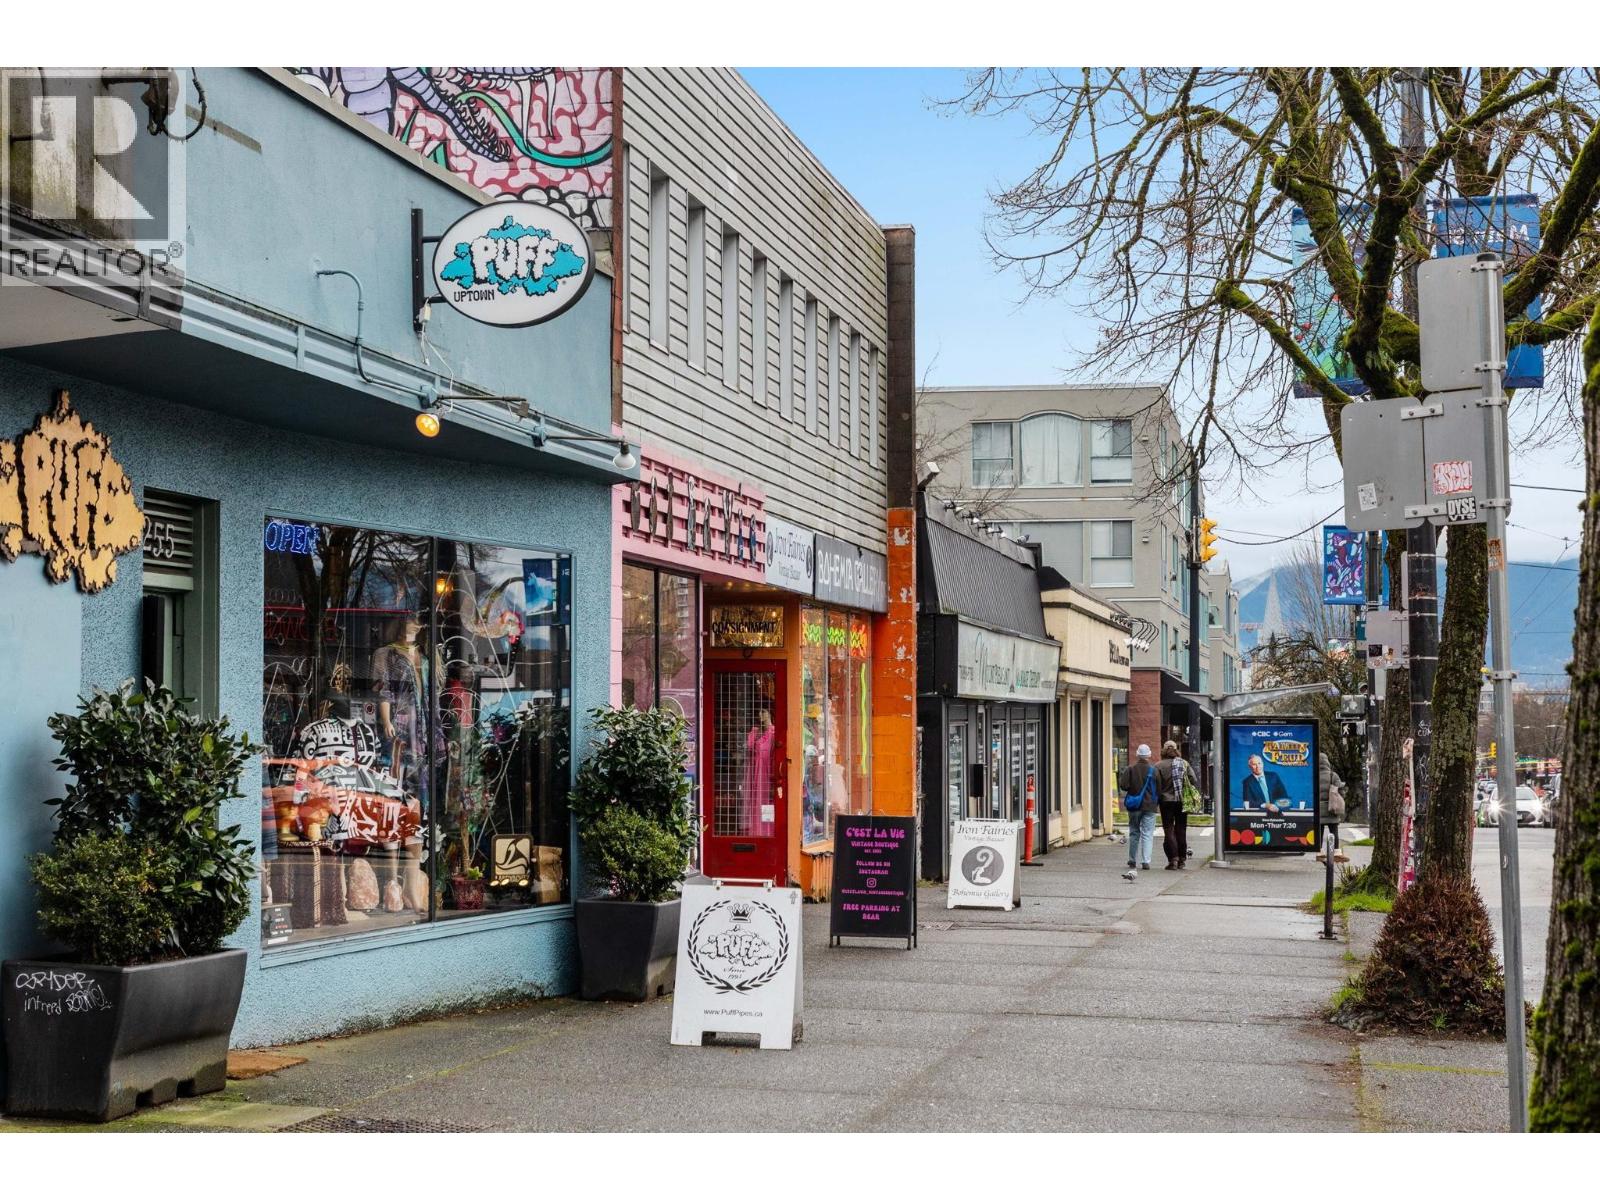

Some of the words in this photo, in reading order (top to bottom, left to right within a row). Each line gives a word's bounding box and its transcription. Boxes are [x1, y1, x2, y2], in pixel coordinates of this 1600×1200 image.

[470, 235, 560, 282] PUFF
[454, 290, 495, 302] UPTOWN
[1448, 498, 1476, 515] DYSE
[1449, 513, 1477, 521] VTS
[265, 518, 319, 554] OPEN
[817, 549, 854, 592] BOHEMIA
[1272, 752, 1306, 764] FEUD
[845, 827, 872, 838] C'EST
[874, 828, 888, 838] LA
[957, 825, 978, 834] Iron
[981, 825, 1015, 836] Fairies
[843, 903, 859, 911] FREE
[716, 933, 762, 960] PUFF
